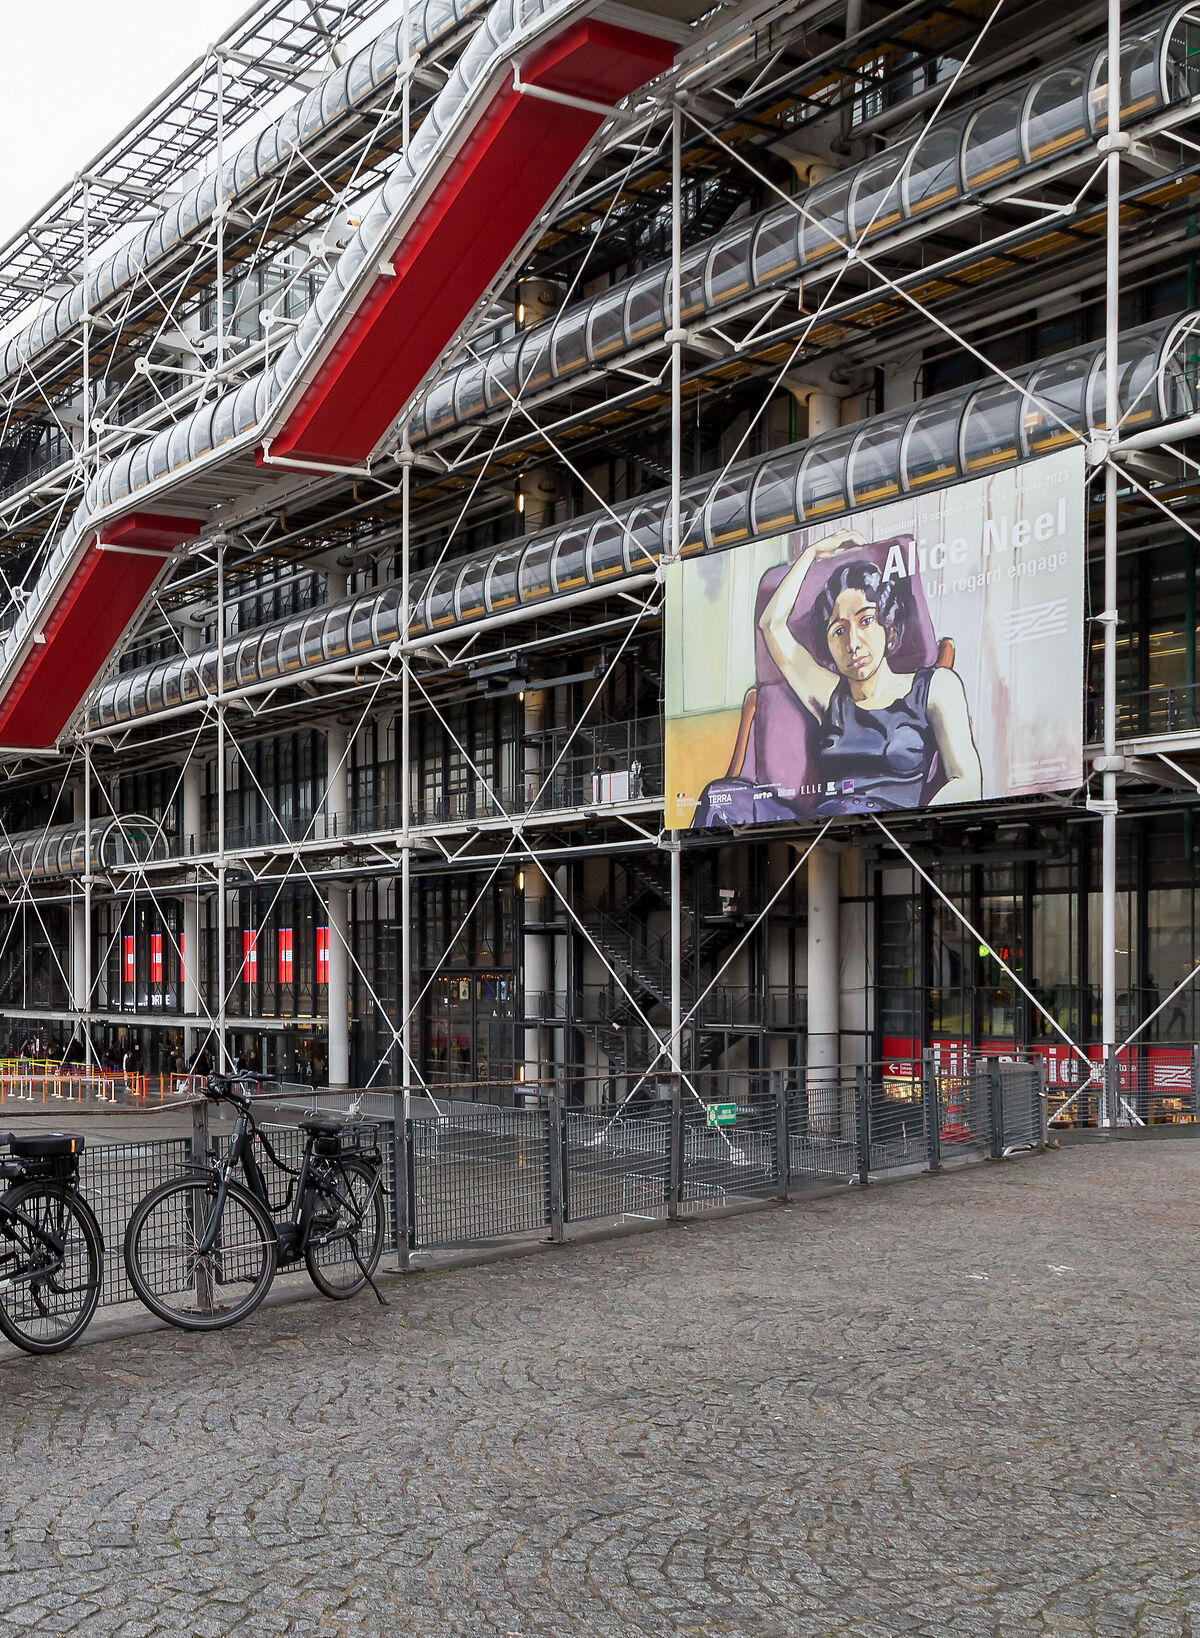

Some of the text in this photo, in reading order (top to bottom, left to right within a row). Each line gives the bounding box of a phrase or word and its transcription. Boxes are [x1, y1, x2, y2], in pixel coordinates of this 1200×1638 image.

[875, 518, 917, 536] Exposition
[1046, 469, 1069, 487] 2023
[882, 497, 1066, 583] Alice Neel
[926, 546, 1068, 598] Un regard engagé
[709, 793, 733, 804] TERRA
[752, 791, 773, 800] arte
[801, 783, 822, 795] ELLE
